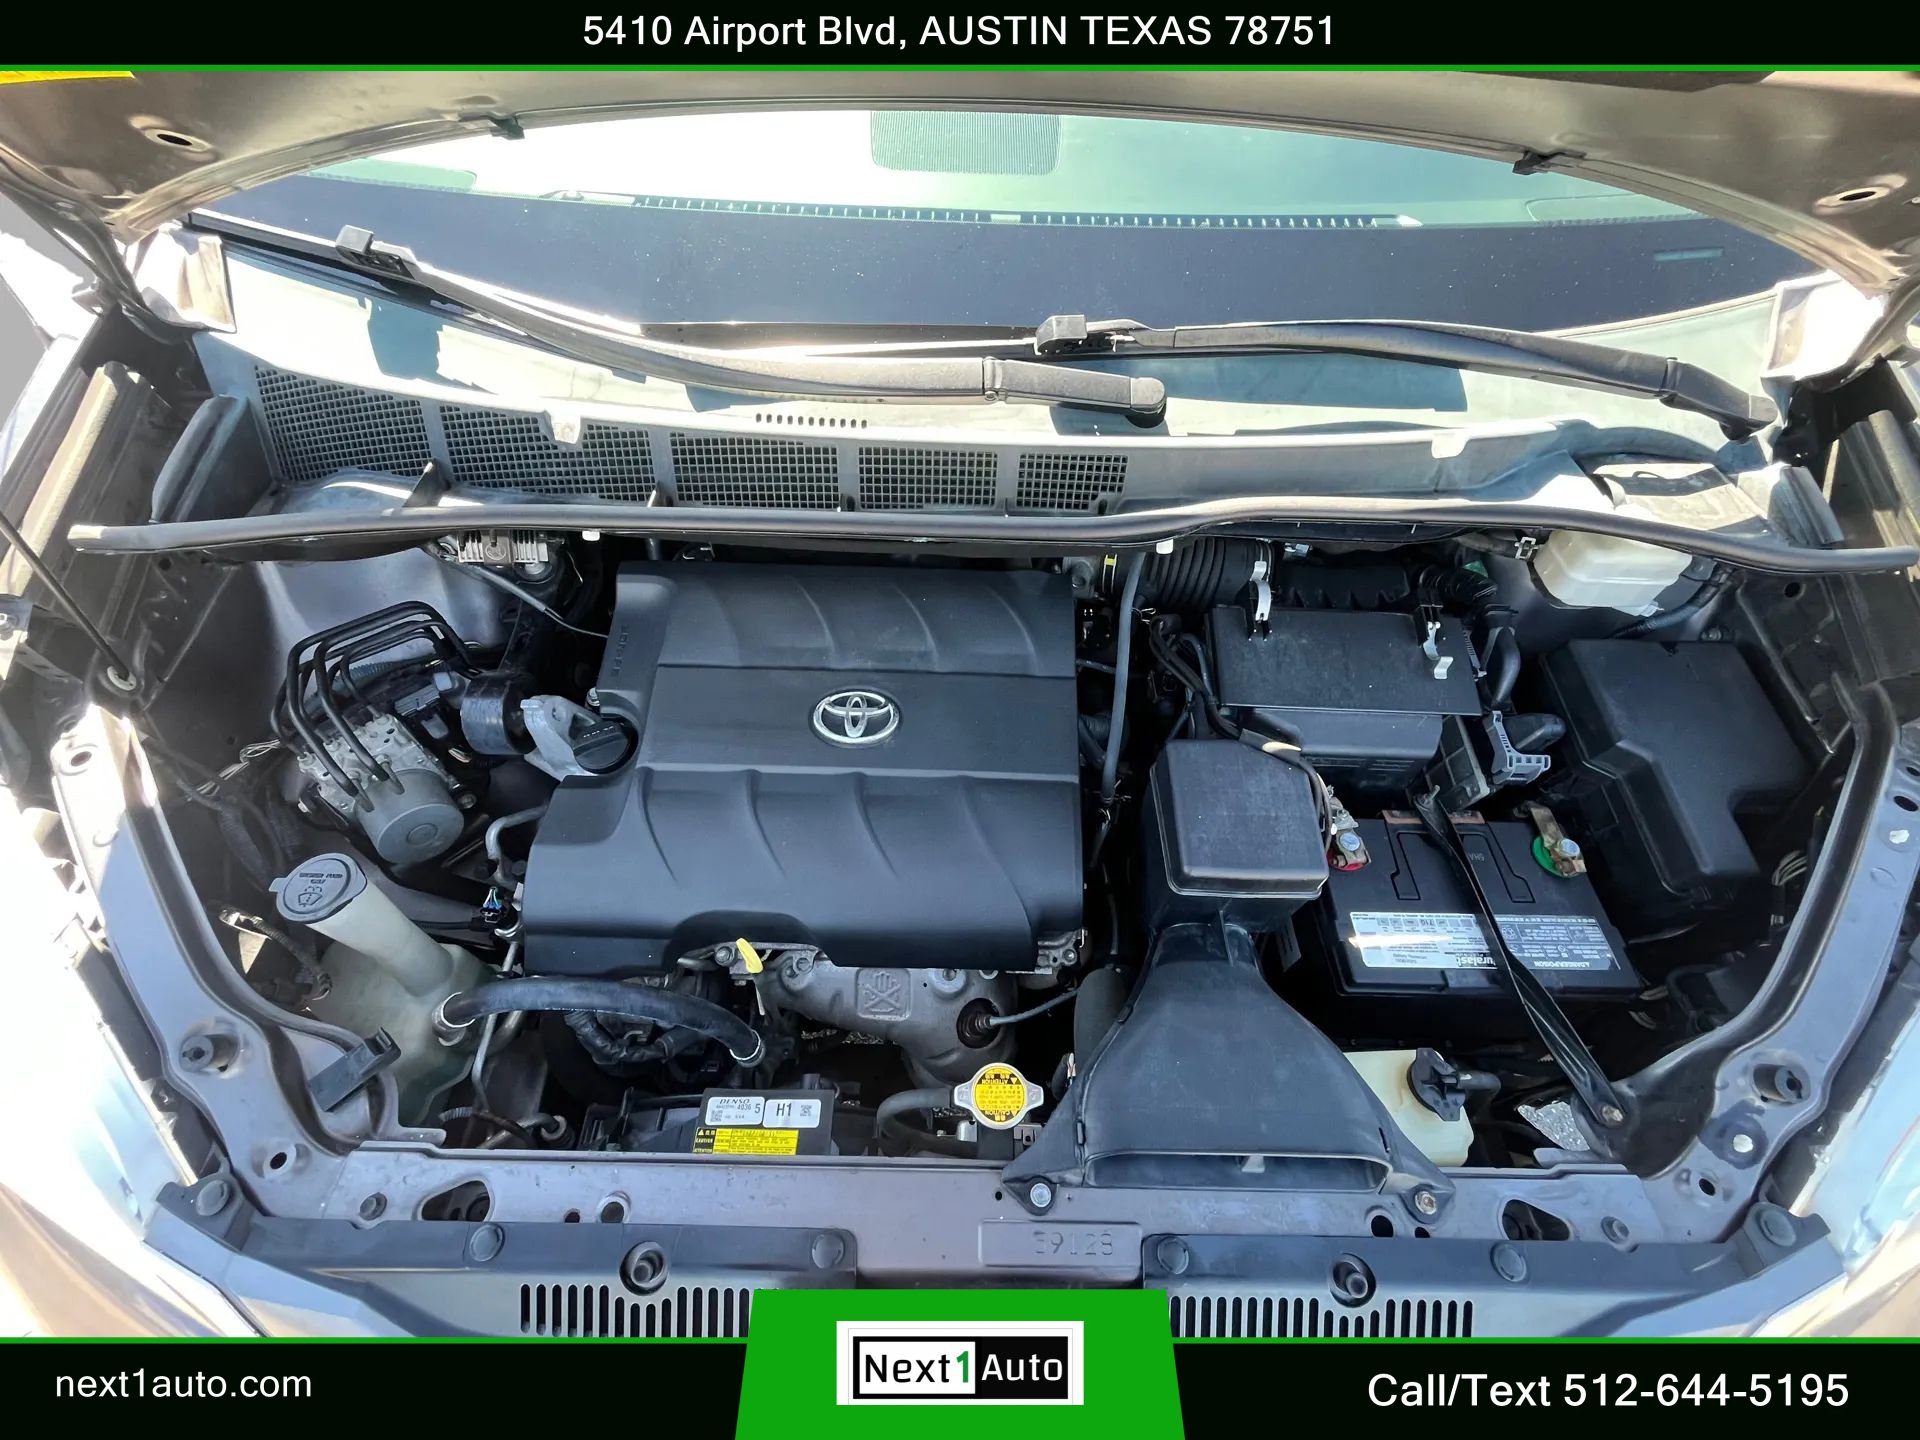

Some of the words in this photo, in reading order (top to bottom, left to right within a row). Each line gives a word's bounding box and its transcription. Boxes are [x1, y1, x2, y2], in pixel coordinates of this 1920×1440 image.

[1457, 956, 1496, 967] uralast
[754, 1103, 761, 1114] 5
[776, 1102, 792, 1117] H1
